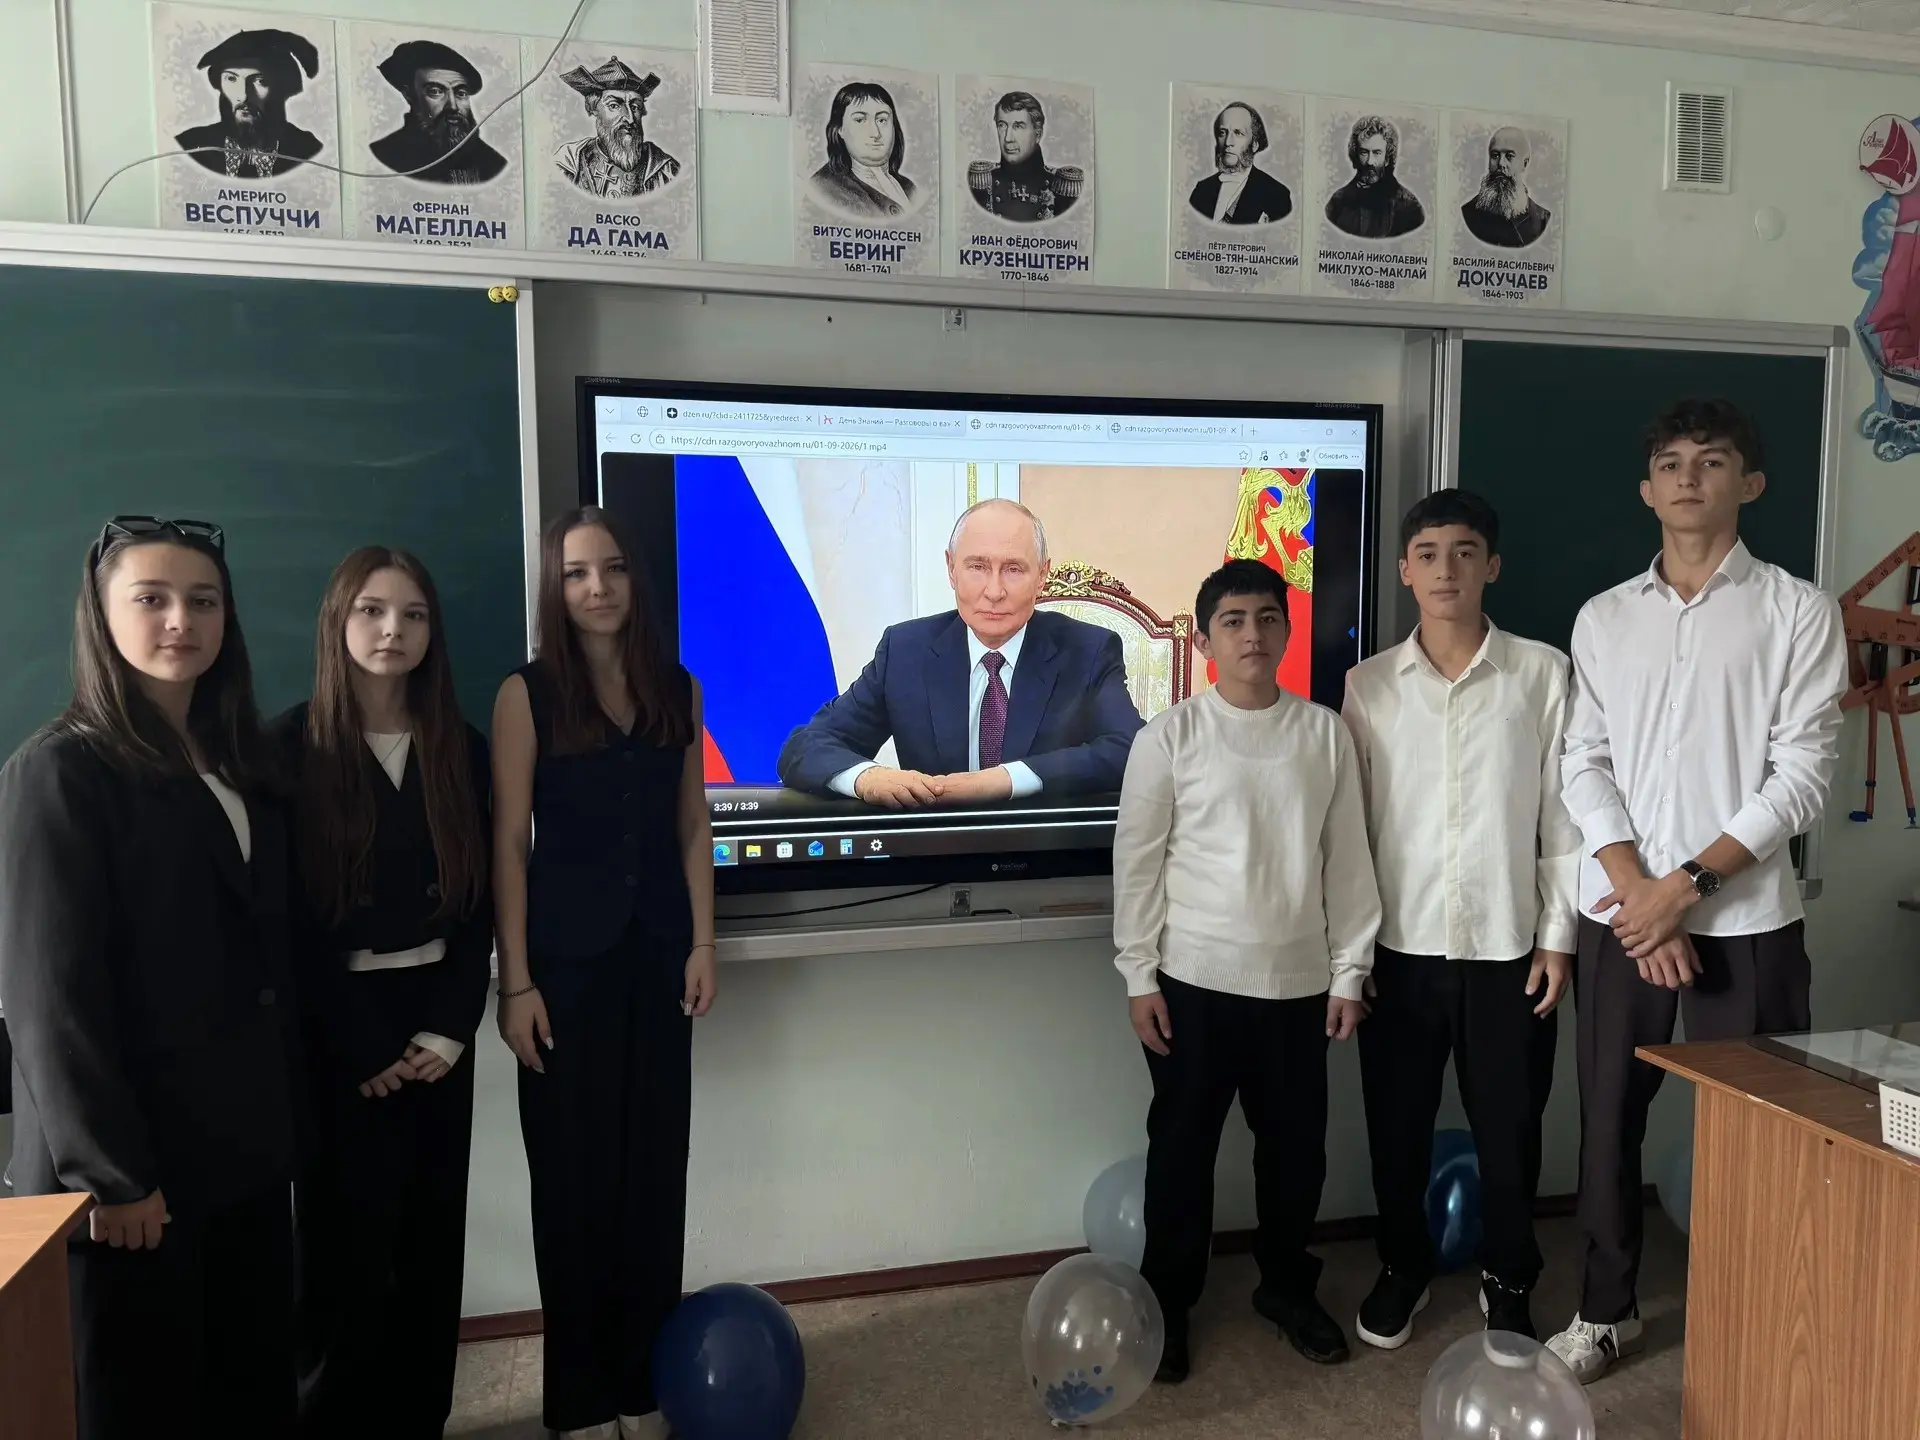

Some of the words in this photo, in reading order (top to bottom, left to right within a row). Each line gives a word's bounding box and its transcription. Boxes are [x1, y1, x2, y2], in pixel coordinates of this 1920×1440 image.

[218, 189, 287, 204] АМЕРИГО
[185, 202, 320, 228] ВЕСПУЧЧИ
[412, 202, 469, 215] ФЕРНАН
[376, 214, 506, 240] МАГЕЛЛАН
[596, 213, 641, 226] ВАСКО
[568, 226, 602, 248] ДА
[608, 228, 669, 250] ГАМА
[813, 226, 852, 238] ВИТУС
[855, 228, 921, 242] ИОНАССЕН
[972, 235, 1002, 246] ИВАН
[1006, 235, 1078, 250] ФЁДОРОВИЧ
[1208, 242, 1226, 250] ПЁТР
[1228, 244, 1266, 252] ПЕТРОВИЧ
[830, 241, 906, 262] БЕРИНГ
[1174, 250, 1299, 266] СЕМЁНОВ-ТЯН-ШАНСКИЙ
[1318, 250, 1364, 261] НИКОЛАЙ
[1366, 252, 1428, 266] НИКОЛАЕВИЧ
[960, 249, 1089, 271] КРУЗЕНШТЕРН
[1453, 257, 1496, 268] ВАСИЛИЙ
[1497, 260, 1554, 272] ВАСИЛЬЕВИЧ
[1318, 262, 1427, 280] МИКЛУХО-МАКЛАЙ
[1458, 270, 1548, 290] ДОКУЧАЕВ
[1318, 452, 1348, 460] Обновить
[714, 802, 733, 812] 3:39
[740, 801, 759, 810] 3:39
